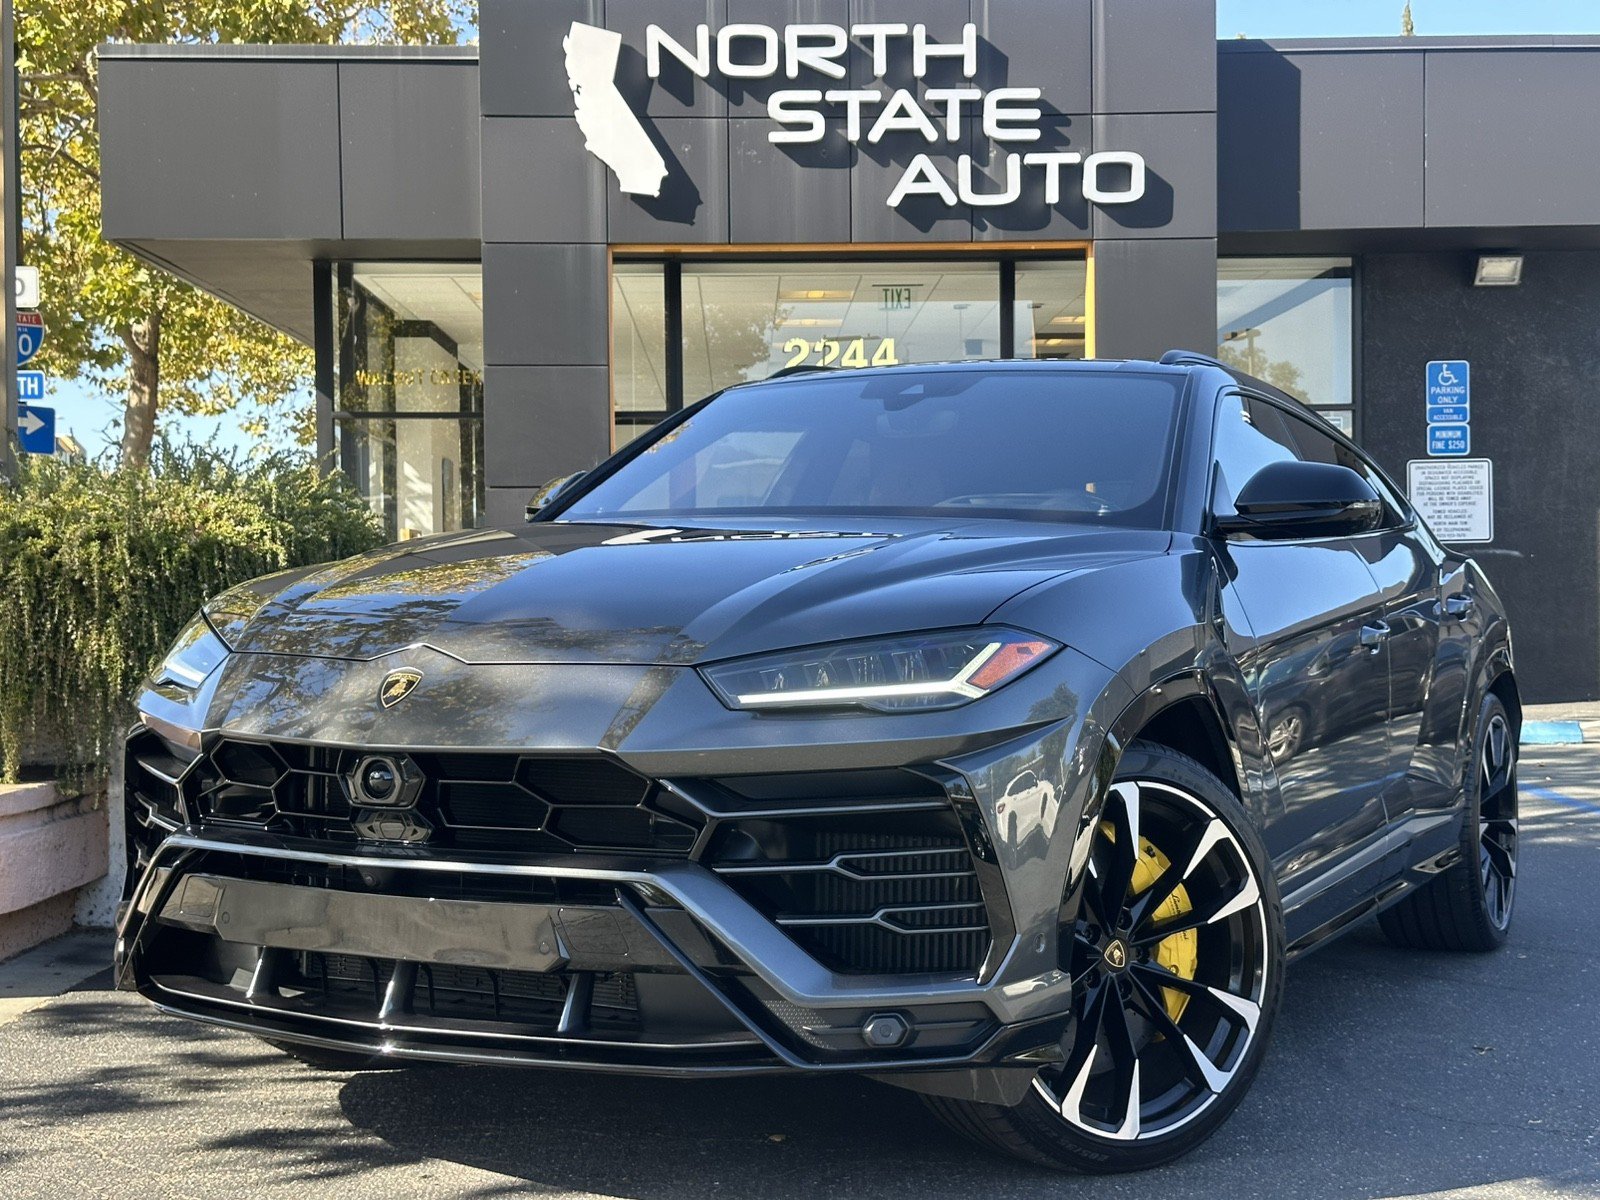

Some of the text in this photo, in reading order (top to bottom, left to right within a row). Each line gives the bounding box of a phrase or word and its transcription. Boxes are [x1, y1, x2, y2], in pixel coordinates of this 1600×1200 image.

[646, 23, 977, 79] NORTH
[767, 88, 1041, 143] STATE
[887, 151, 1145, 207] AUTO
[783, 337, 899, 368] 2244
[1430, 386, 1466, 394] PARKING
[1437, 396, 1459, 404] ONLY
[1432, 440, 1466, 449] FINE $250
